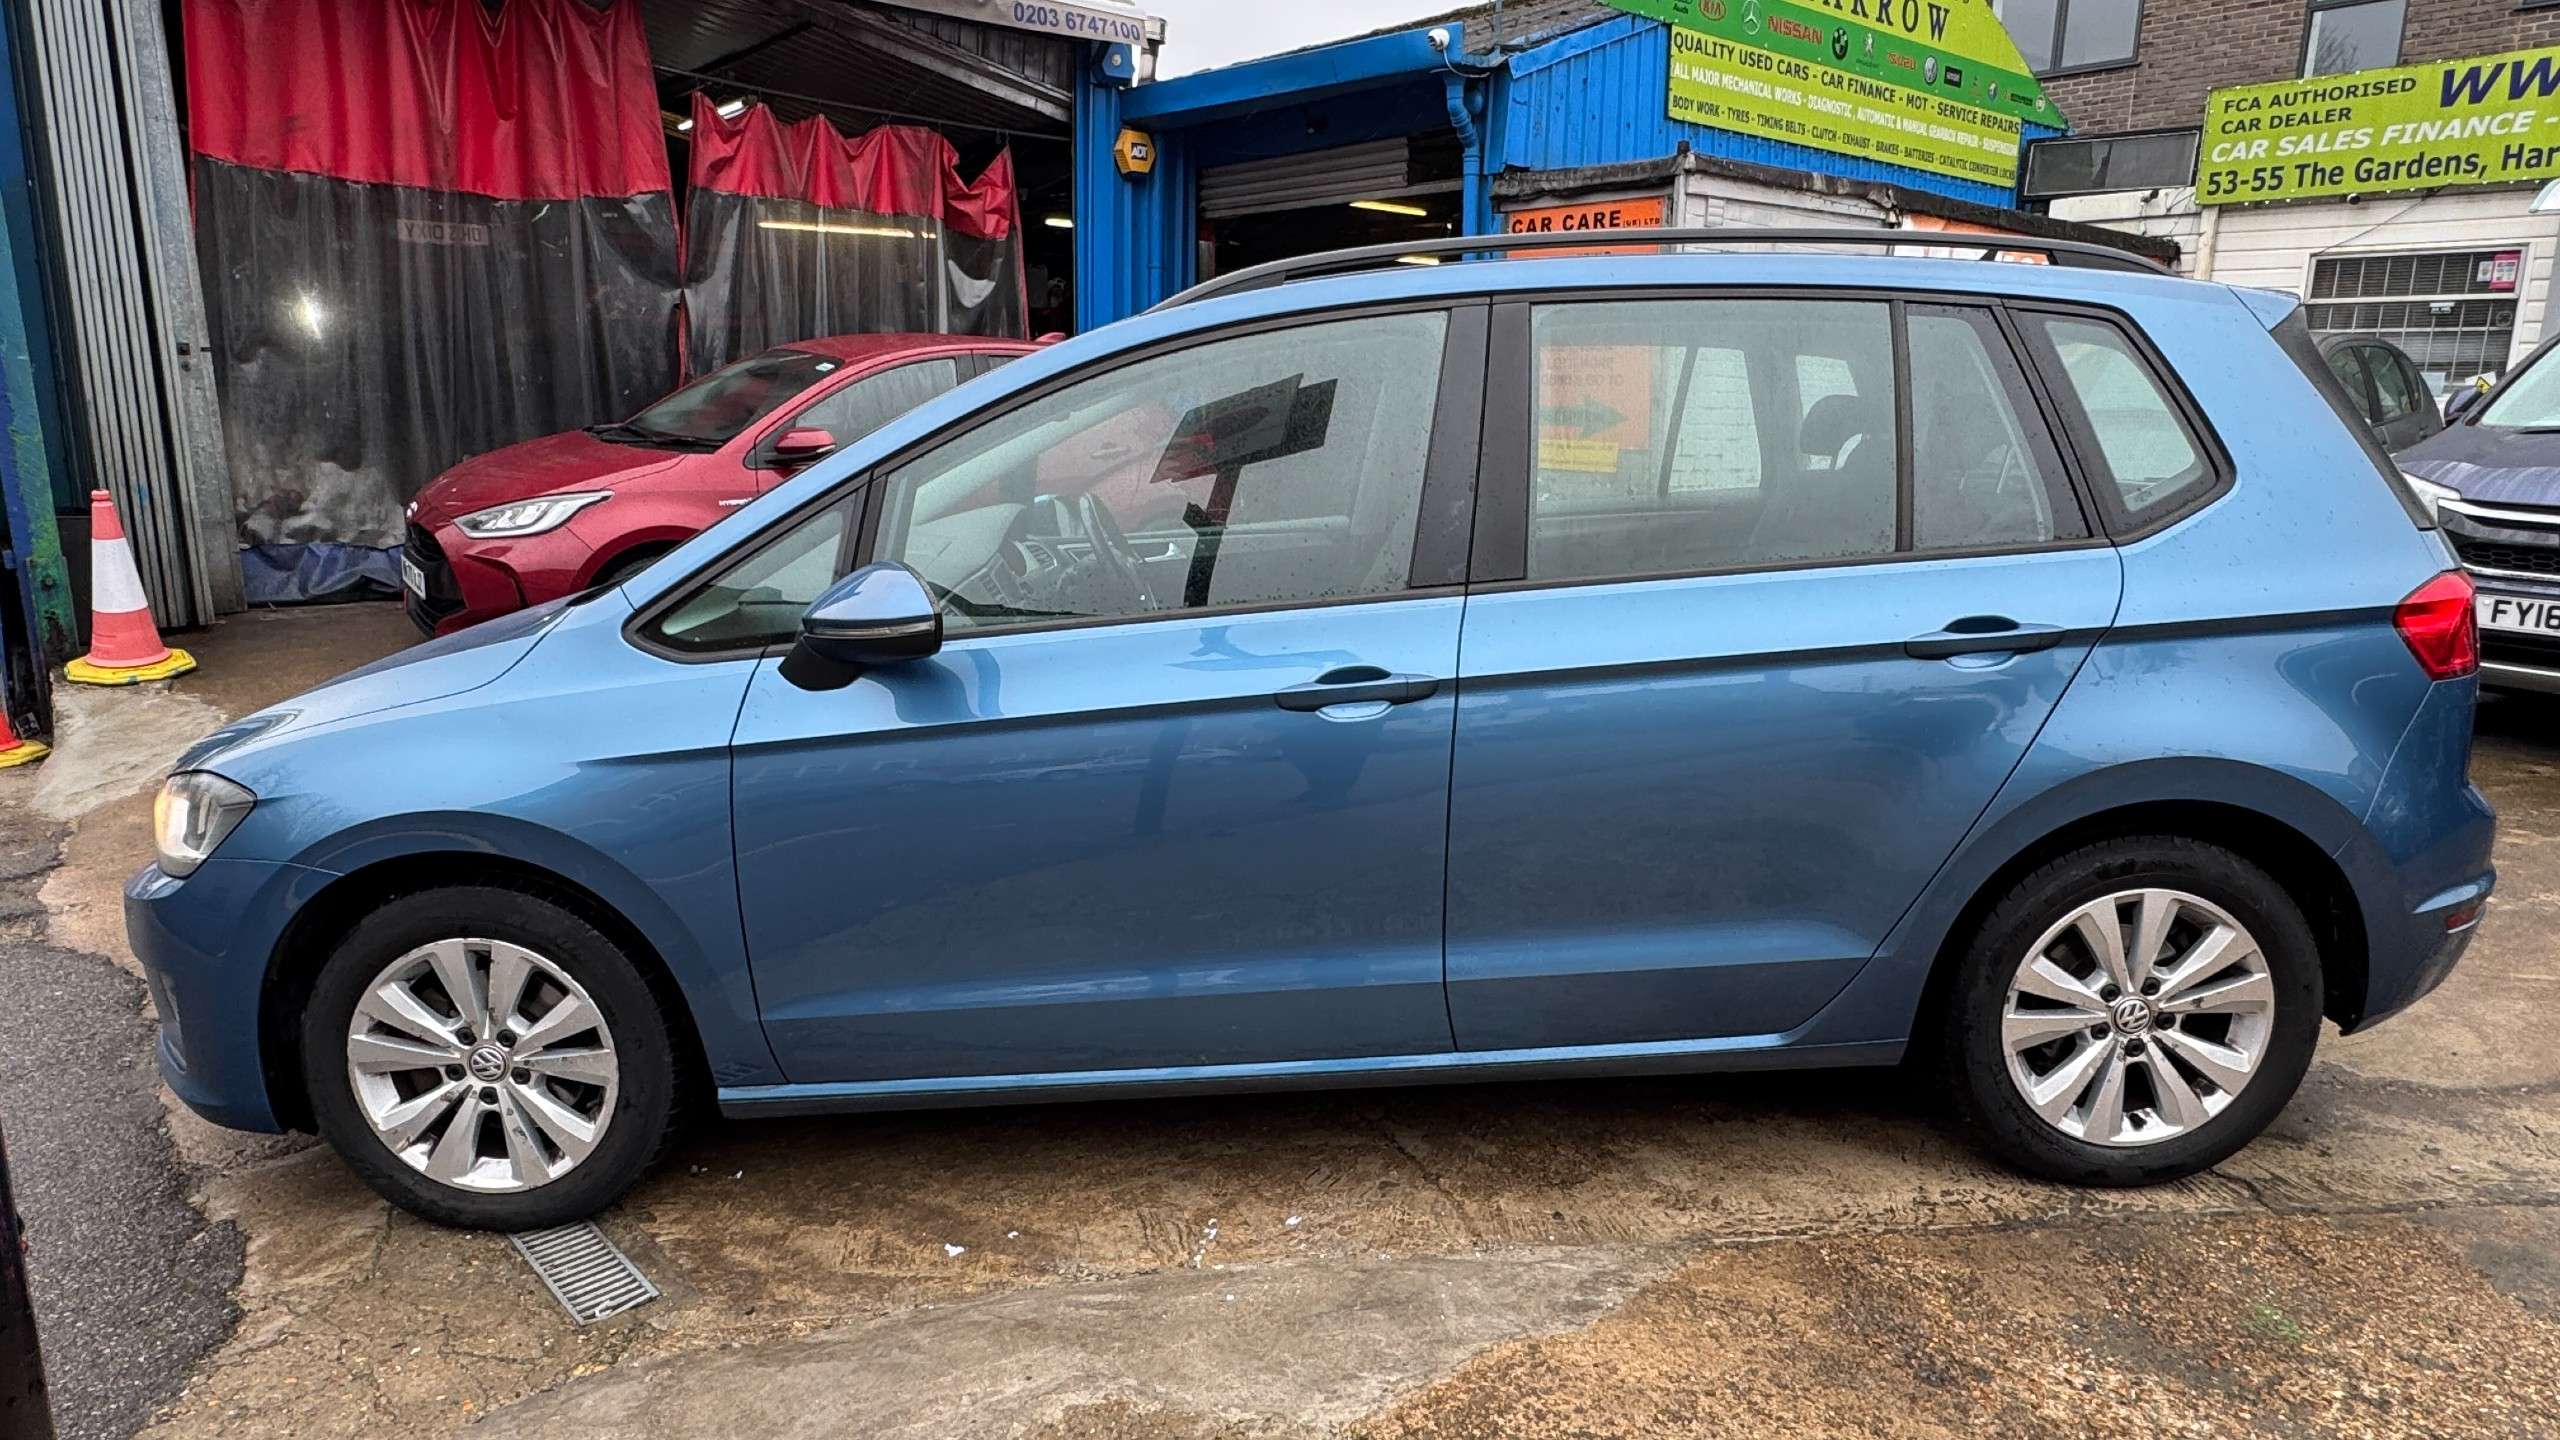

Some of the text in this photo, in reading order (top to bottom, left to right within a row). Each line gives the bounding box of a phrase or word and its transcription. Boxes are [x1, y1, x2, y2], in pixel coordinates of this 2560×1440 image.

[1014, 2, 1140, 40] 0203 6747100
[1768, 16, 1823, 45] NISSAN
[1674, 32, 1735, 61] QUALITY
[1739, 50, 1772, 71] USED
[1777, 60, 1809, 81] CARS
[1821, 70, 1844, 90] CAR
[1847, 78, 1896, 104] FINANCE
[1906, 92, 1928, 111] MOT
[1937, 102, 1978, 124] SERVICE
[1981, 115, 2020, 134] REPAIRS
[1674, 63, 1690, 80] ALL
[1692, 66, 1720, 86] MAJOR
[1721, 73, 1773, 100] MECHANICAL
[1775, 86, 1802, 106] WORKS
[2224, 78, 2416, 114] FCA AUTHORISED
[1672, 95, 1694, 110] BODY
[1696, 101, 1720, 117] WORK
[1727, 107, 1750, 122] TYRES
[1756, 114, 1784, 130] TIMING
[1785, 120, 1805, 135] BELTS
[1812, 126, 1837, 142] CLUTCH
[1842, 133, 1870, 148] EXHAUST
[1876, 141, 1899, 155] BRAKES
[1904, 146, 1935, 163] BATTERIES
[2212, 139, 2269, 163] CAR
[2275, 128, 2374, 156] SALES
[2380, 110, 2536, 146] FINANCE
[2221, 107, 2352, 134] CAR DEALER
[1132, 145, 1148, 158] ADT
[2206, 166, 2285, 196] 53-55
[2295, 162, 2344, 188] The
[2354, 151, 2488, 182] Gardens,
[1512, 217, 1552, 234] CAR
[1563, 210, 1621, 230] CARE
[2490, 600, 2560, 629] FY16
